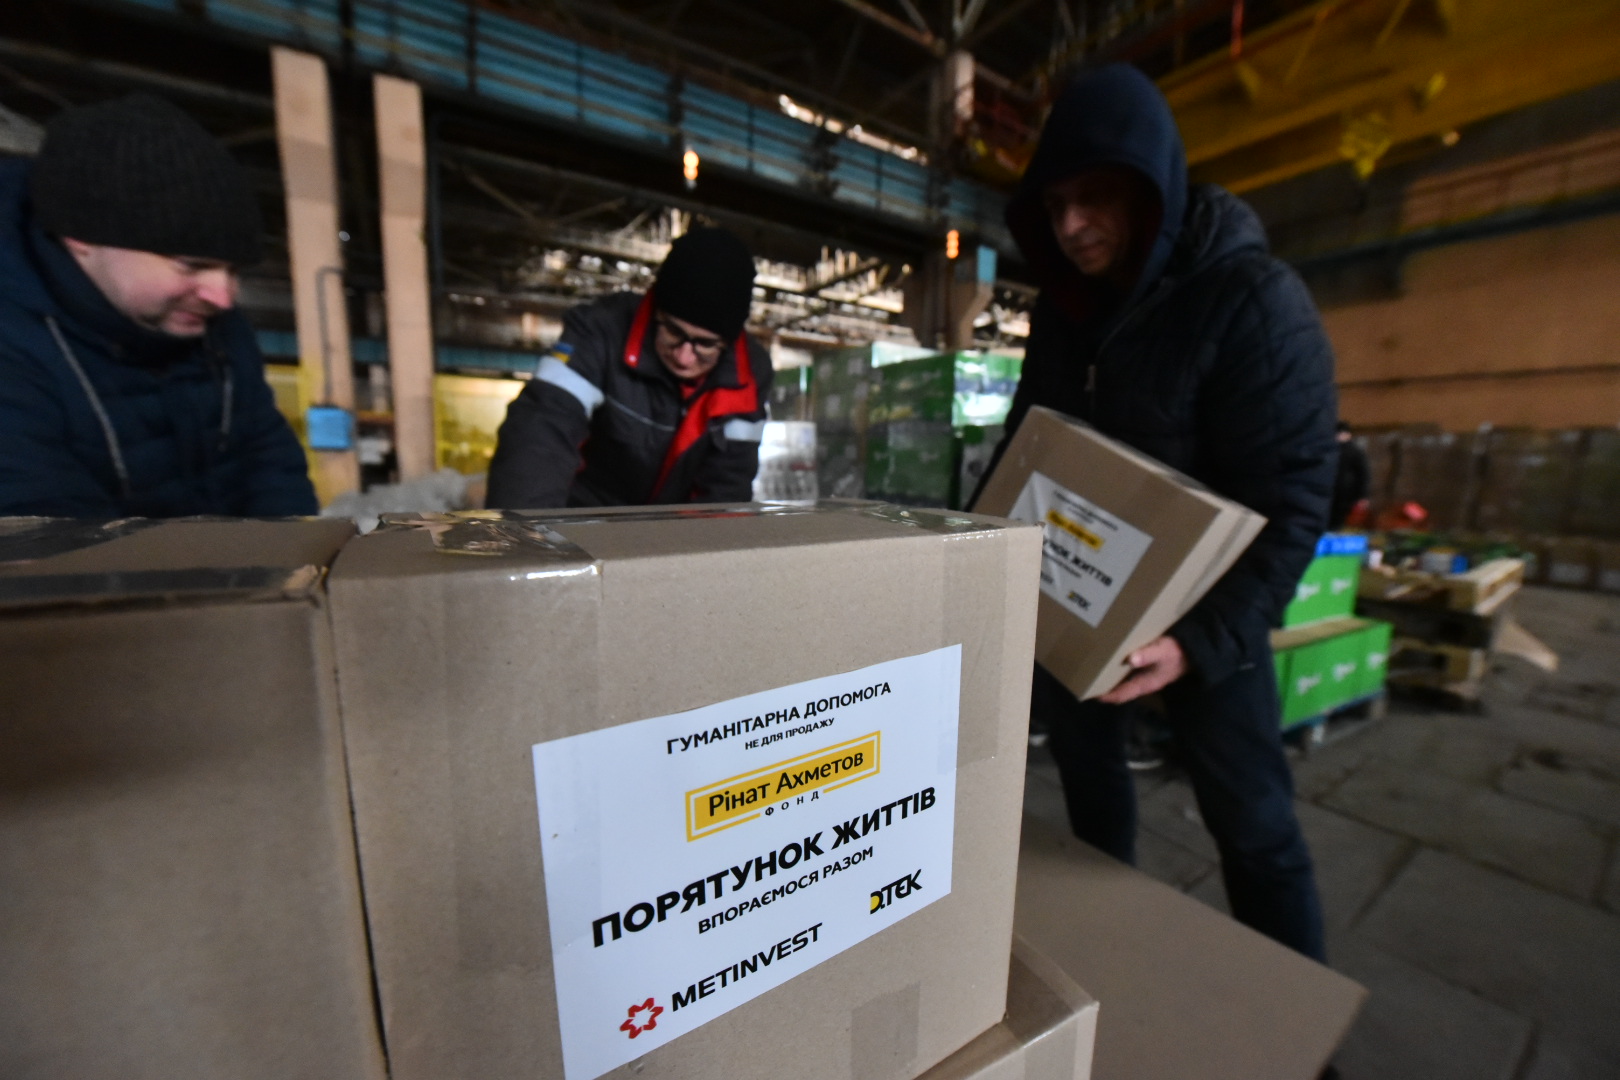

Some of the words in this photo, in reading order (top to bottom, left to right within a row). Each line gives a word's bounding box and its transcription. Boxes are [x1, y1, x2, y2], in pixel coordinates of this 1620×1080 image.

[667, 706, 800, 754] ГУМАНІТАРНА
[804, 682, 891, 719] ДОПОМОГА
[745, 740, 759, 750] НЕ
[761, 732, 783, 746] ДЛЯ
[785, 718, 835, 738] ПРОДАЖУ
[708, 783, 771, 817] Рінат
[776, 751, 864, 794] Ахметов
[764, 790, 819, 816] ФОНД
[592, 832, 824, 948] ПОРЯТУНОК
[831, 787, 936, 849] ЖИТТІВ
[698, 870, 819, 934] ВПОРАЄМОСЯ
[823, 846, 874, 878] РАЗОМ
[671, 922, 823, 1012] METINVEST
